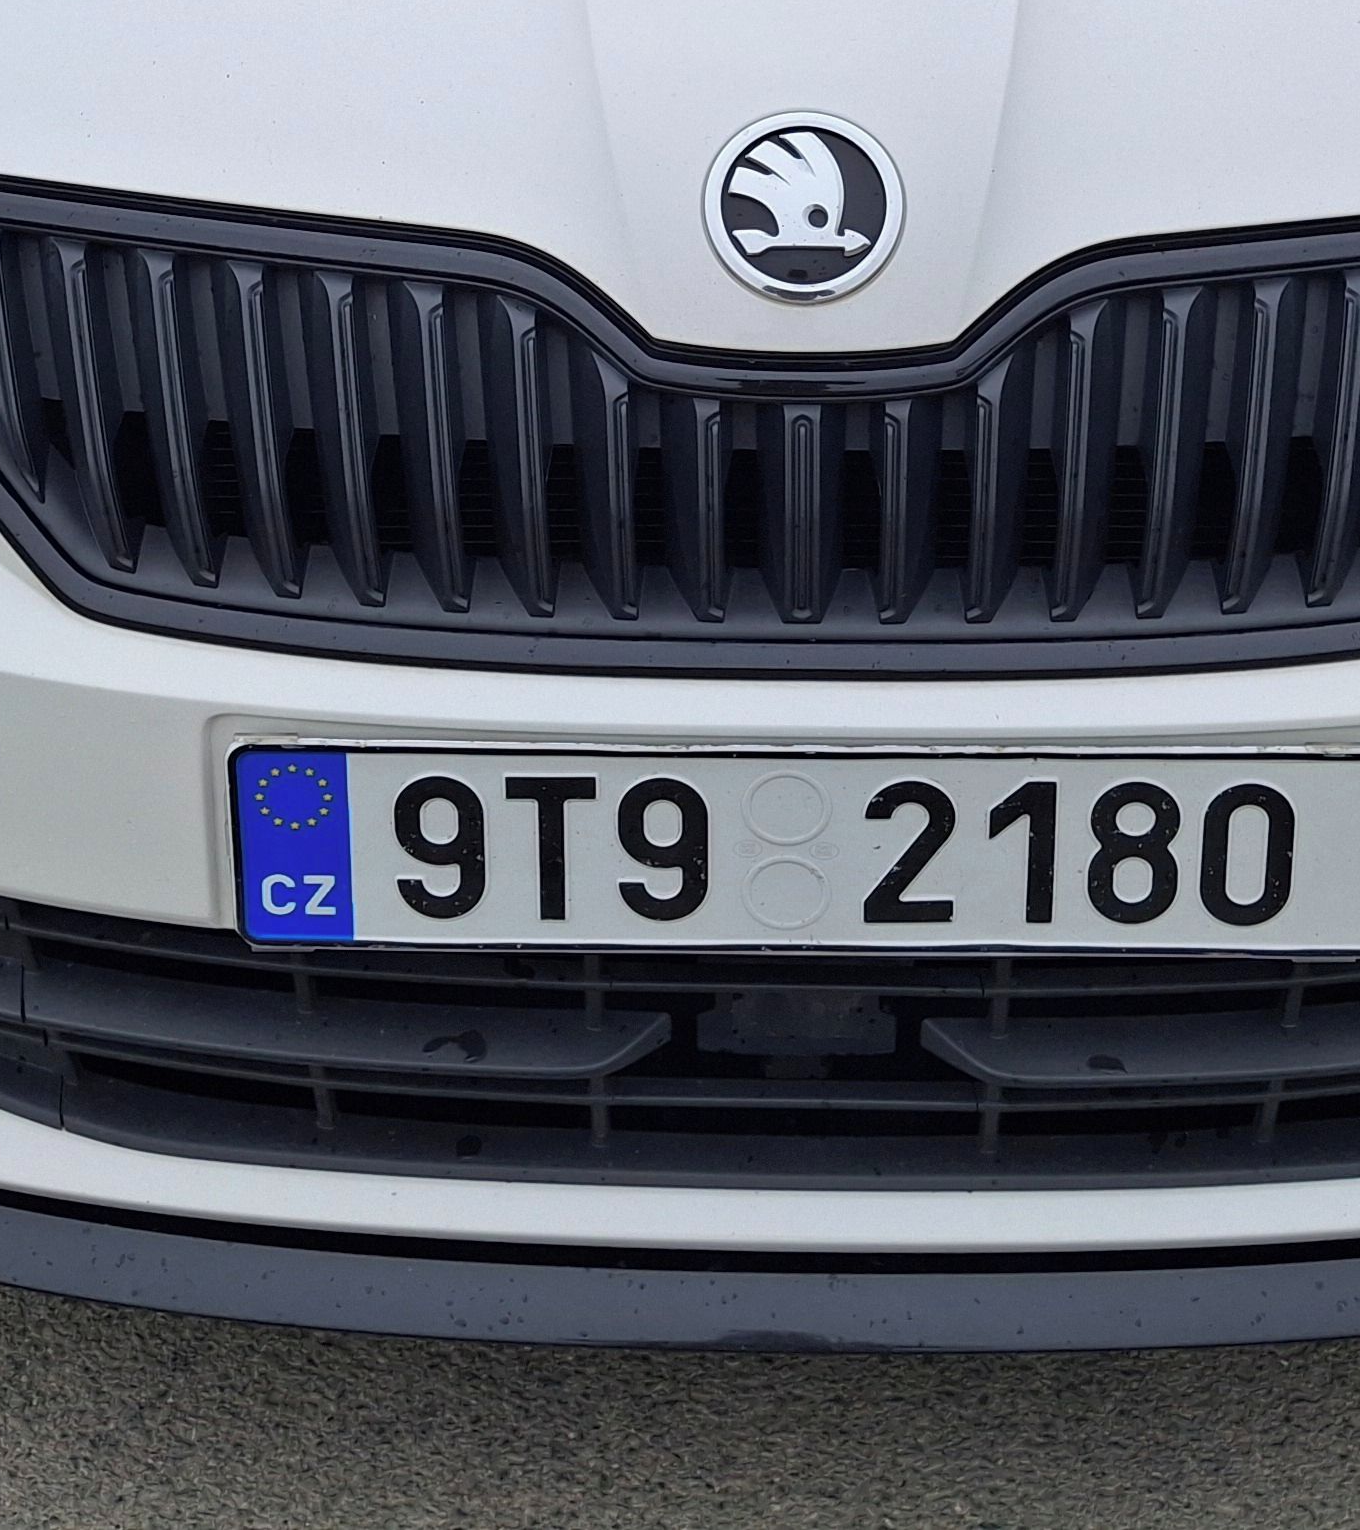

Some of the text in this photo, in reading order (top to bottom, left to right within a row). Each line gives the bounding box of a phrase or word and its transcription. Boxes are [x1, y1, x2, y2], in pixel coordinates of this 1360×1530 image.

[260, 873, 337, 916] CZ
[392, 775, 1296, 926] 9T9 2180
